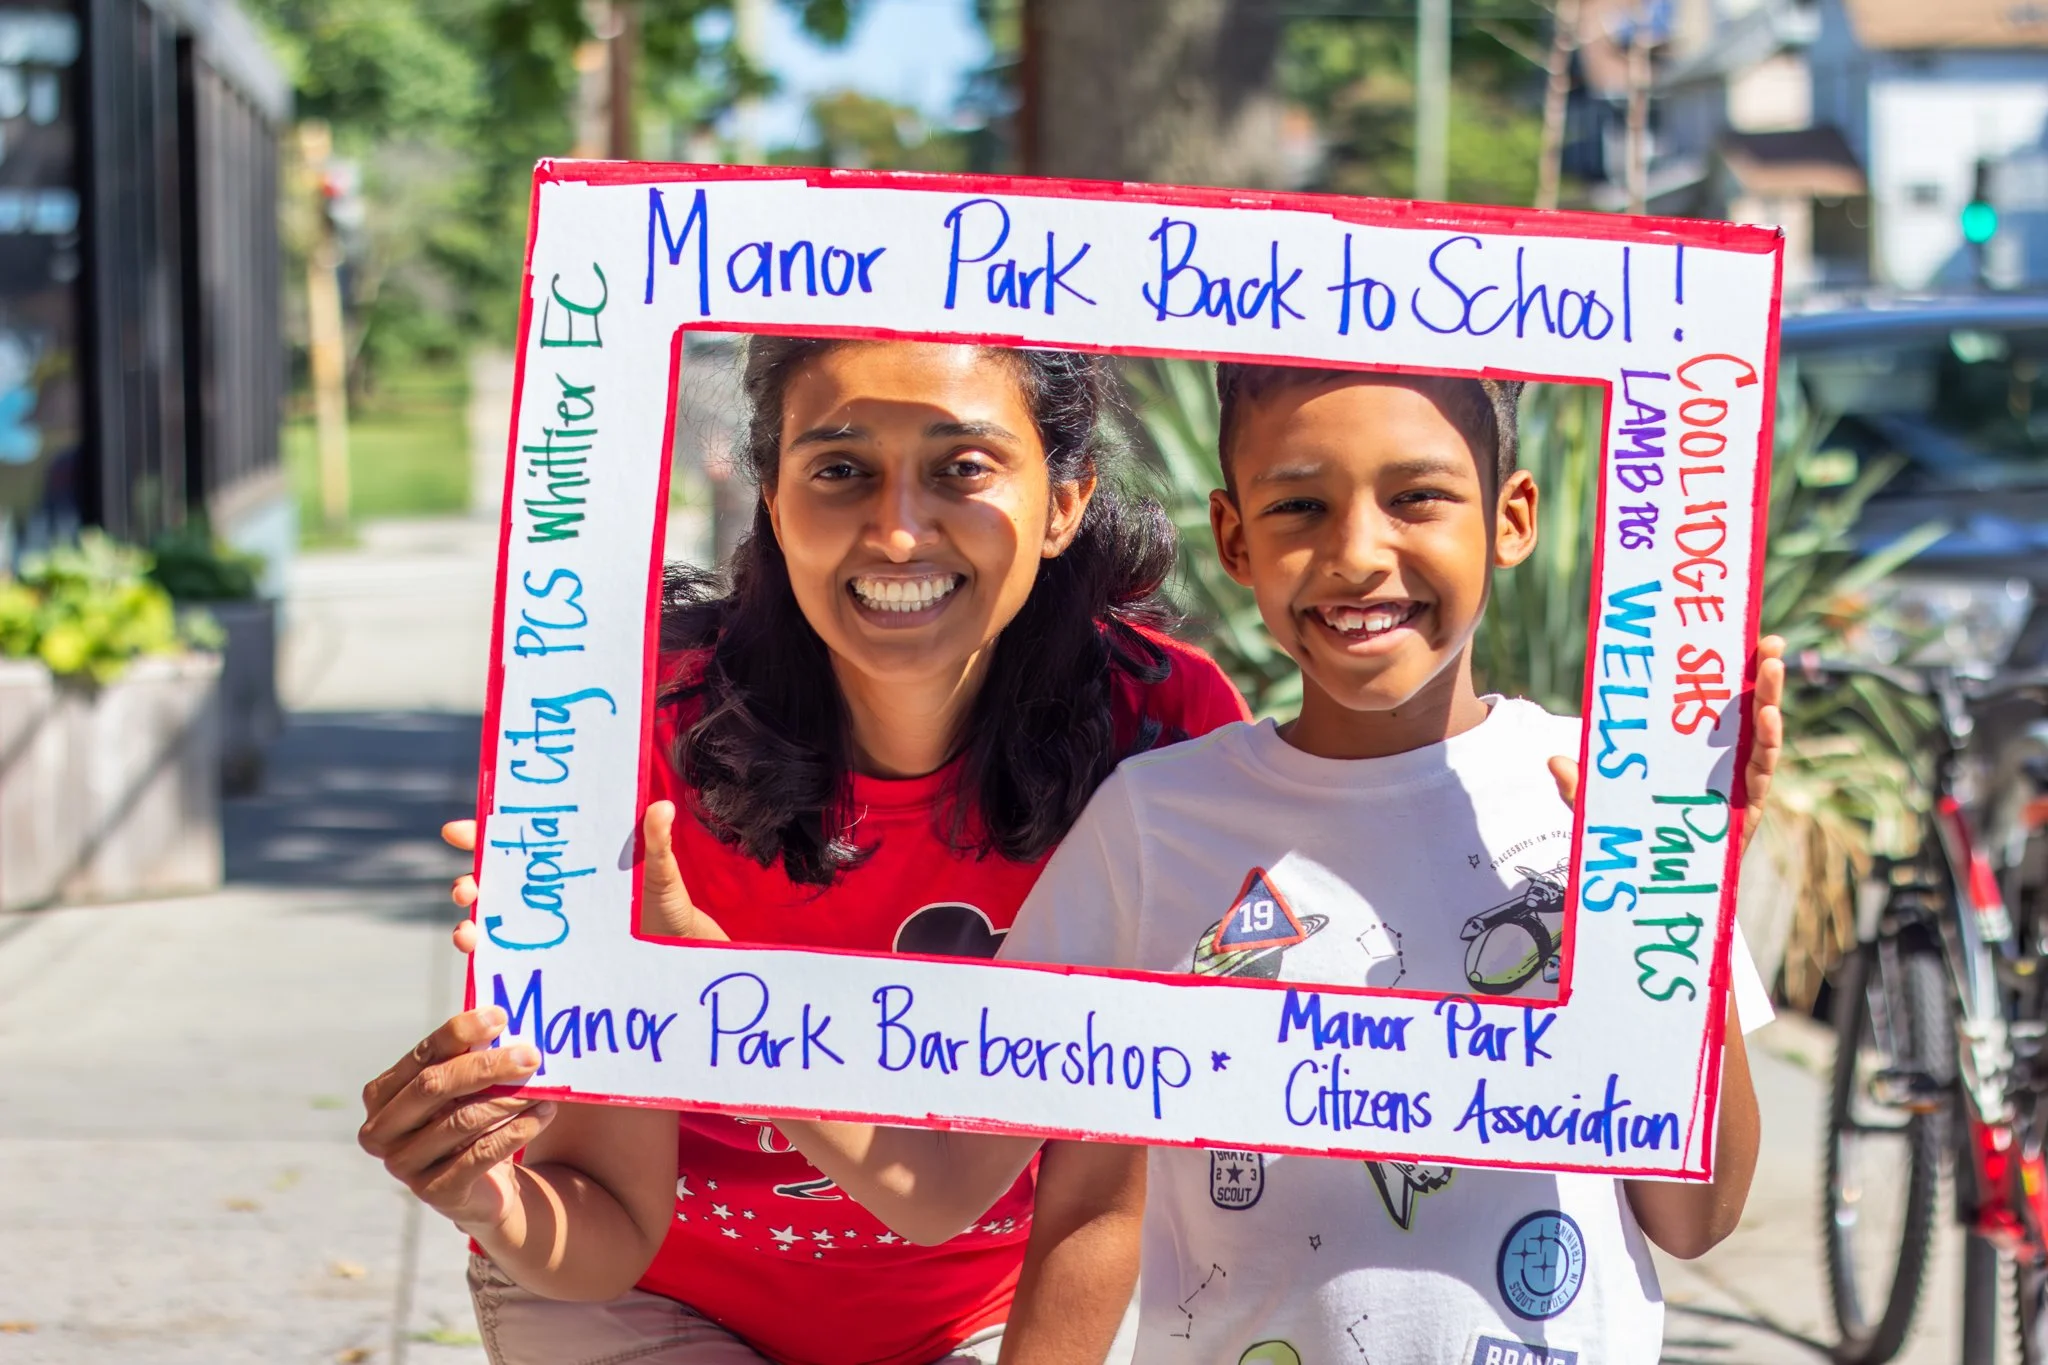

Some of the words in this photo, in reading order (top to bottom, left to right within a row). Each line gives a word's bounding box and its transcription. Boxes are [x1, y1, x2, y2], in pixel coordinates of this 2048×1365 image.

[540, 262, 608, 349] EC
[644, 187, 887, 316] Manor
[1142, 216, 1306, 327] Back
[1327, 232, 1396, 336] to
[522, 373, 599, 543] Whittier
[1614, 367, 1672, 494] LAMB
[1672, 353, 1758, 627] COOLIDGE
[513, 567, 589, 658] PCS
[1596, 580, 1664, 781] WELLS
[1671, 643, 1731, 736] SHS
[504, 686, 618, 785] City
[484, 804, 597, 952] Capital
[1581, 824, 1644, 913] MS
[1638, 788, 1731, 895] Paul
[1239, 899, 1274, 933] 19
[1632, 912, 1704, 1002] PCS
[490, 968, 677, 1077] Manor
[871, 984, 1192, 1120] Barbershop
[1277, 988, 1414, 1052] Manor
[1285, 1053, 1433, 1134] Citizens
[1453, 1073, 1680, 1157] Association
[1216, 1167, 1222, 1180] 2
[1250, 1168, 1257, 1181] 3
[1217, 1186, 1252, 1202] SCOUT
[1509, 1281, 1535, 1311] SCOUT
[1554, 1222, 1581, 1265] TRAINING
